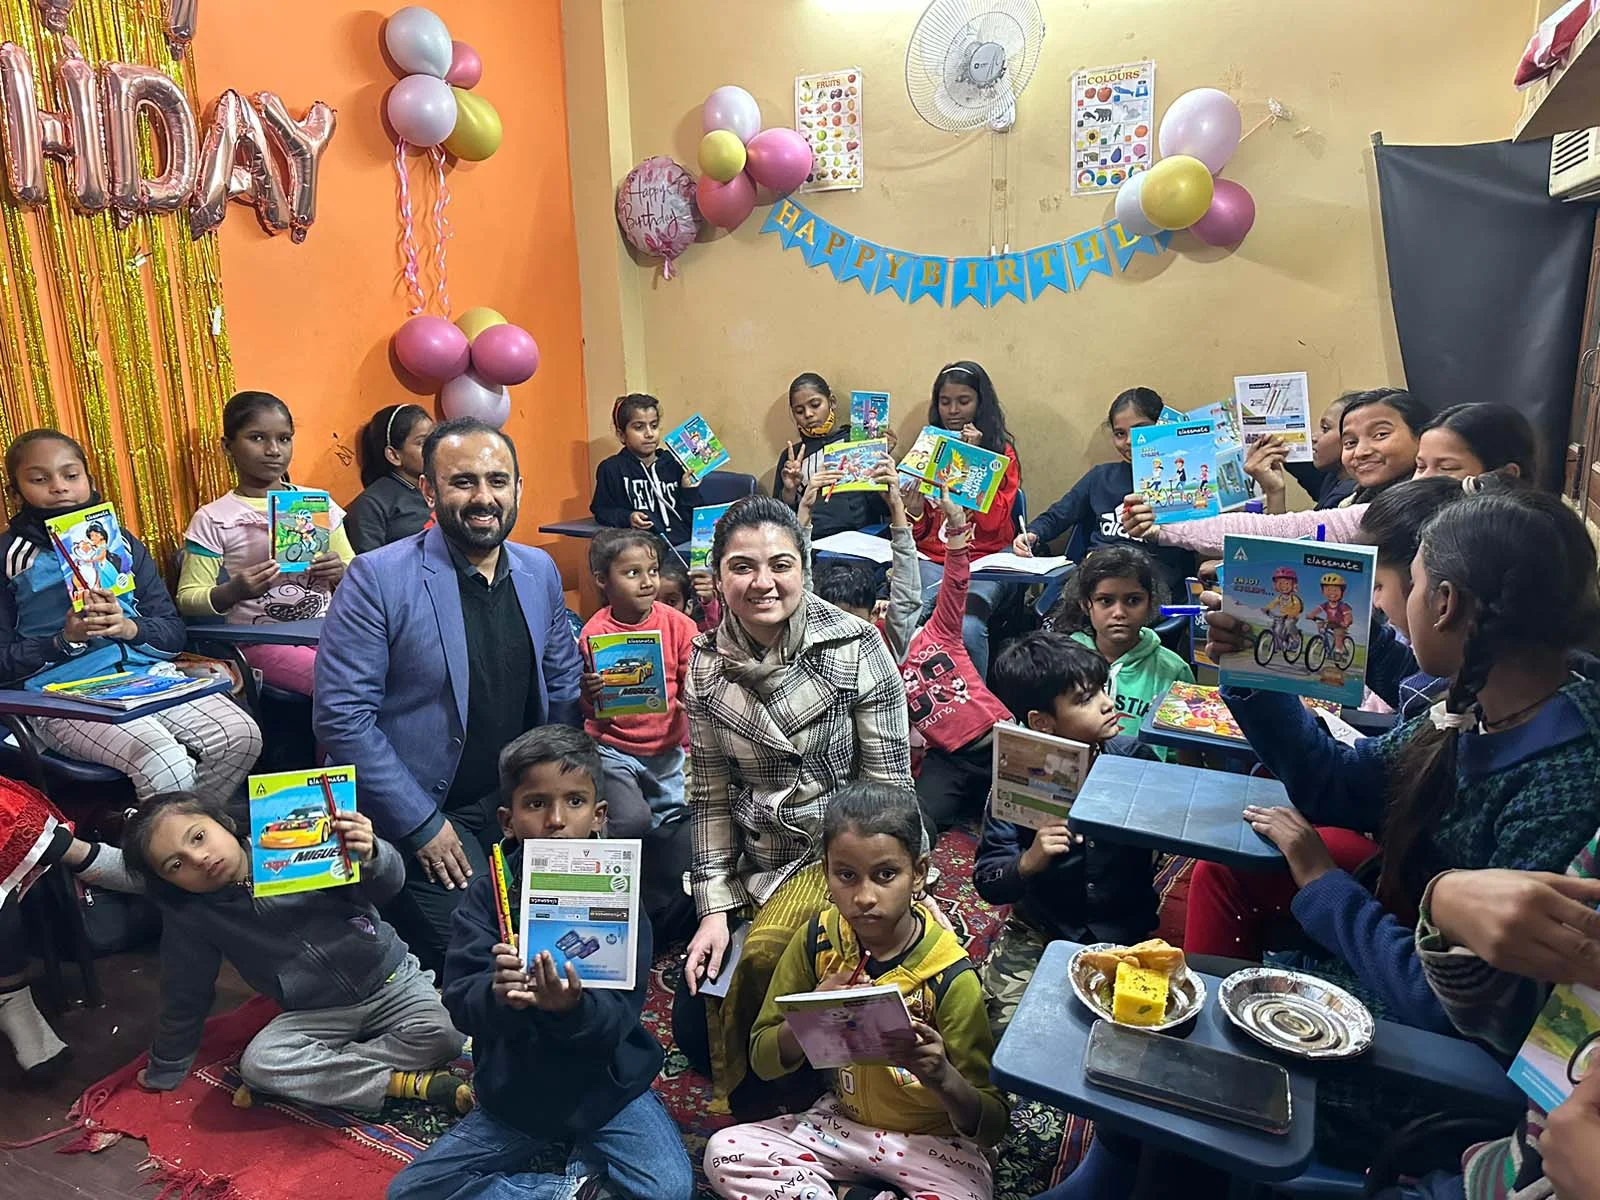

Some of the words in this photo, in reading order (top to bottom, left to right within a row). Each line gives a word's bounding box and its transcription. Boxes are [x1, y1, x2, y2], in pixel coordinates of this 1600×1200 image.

[816, 79, 841, 89] FRUITS
[1087, 70, 1140, 85] COLOURS
[1306, 555, 1361, 571] classmate
[309, 775, 347, 787] clamate
[293, 847, 342, 863] MIGUE
[712, 1152, 745, 1169] Bear
